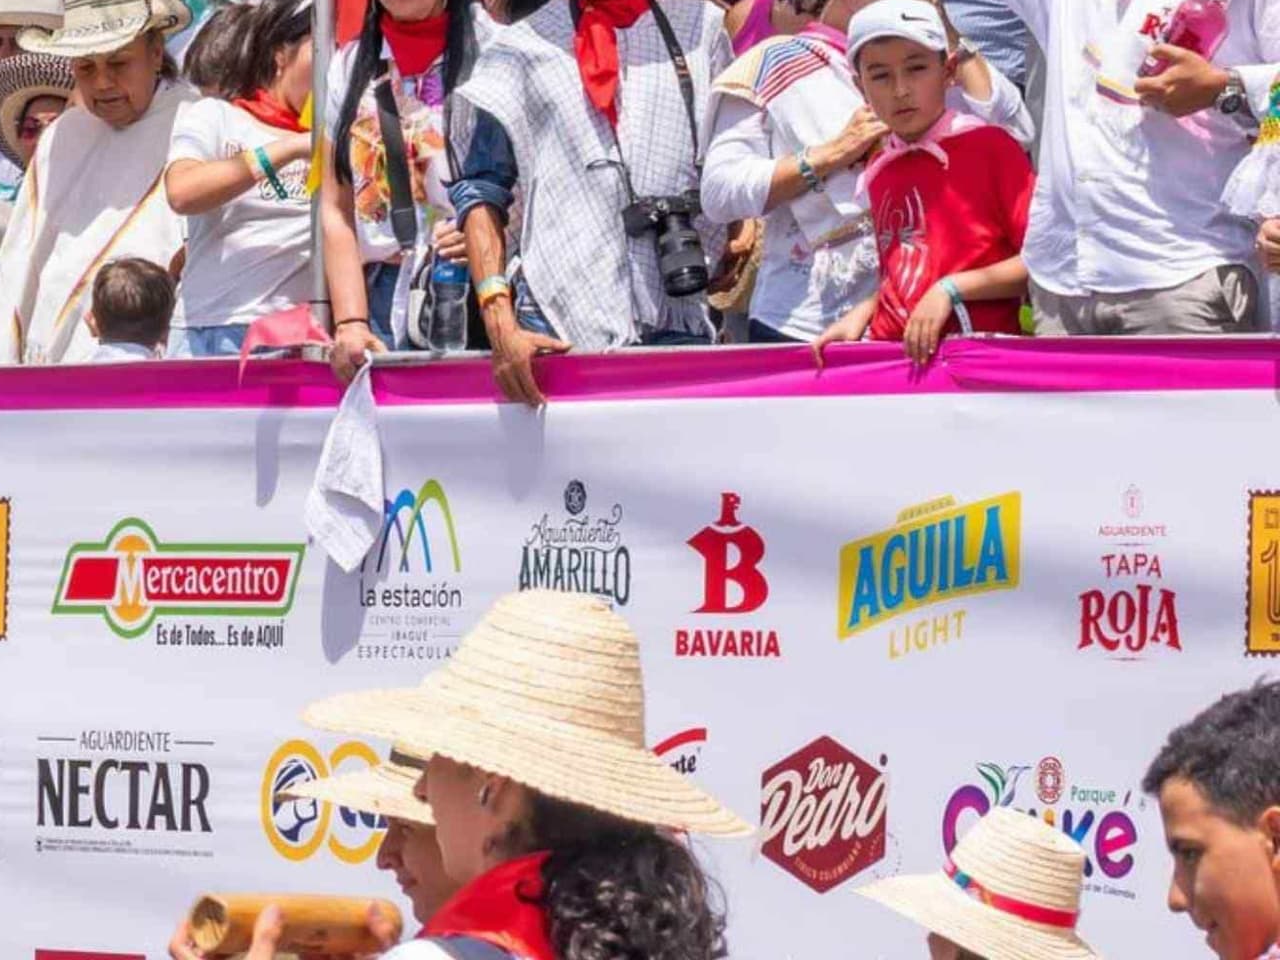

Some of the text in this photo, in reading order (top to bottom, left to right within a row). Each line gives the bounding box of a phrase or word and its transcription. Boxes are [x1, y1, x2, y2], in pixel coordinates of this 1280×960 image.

[117, 550, 280, 608] Mercacentro
[518, 545, 630, 606] AMARILLO
[847, 505, 1009, 628] AGUILA
[1101, 553, 1162, 579] TAPA
[359, 580, 462, 607] la estación
[156, 624, 168, 645] Es
[170, 624, 183, 645] de
[227, 626, 239, 646] Es
[241, 626, 254, 646] de
[888, 609, 966, 660] LIGHT
[1077, 584, 1182, 652] ROJA
[358, 645, 458, 660] ESPECTACULA
[675, 629, 781, 657] BAVARIA
[80, 730, 171, 752] AGUARDIENTE
[804, 756, 843, 792] Don
[36, 758, 213, 833] NECTAR
[761, 762, 888, 857] Pedro
[1071, 786, 1116, 805] Parque
